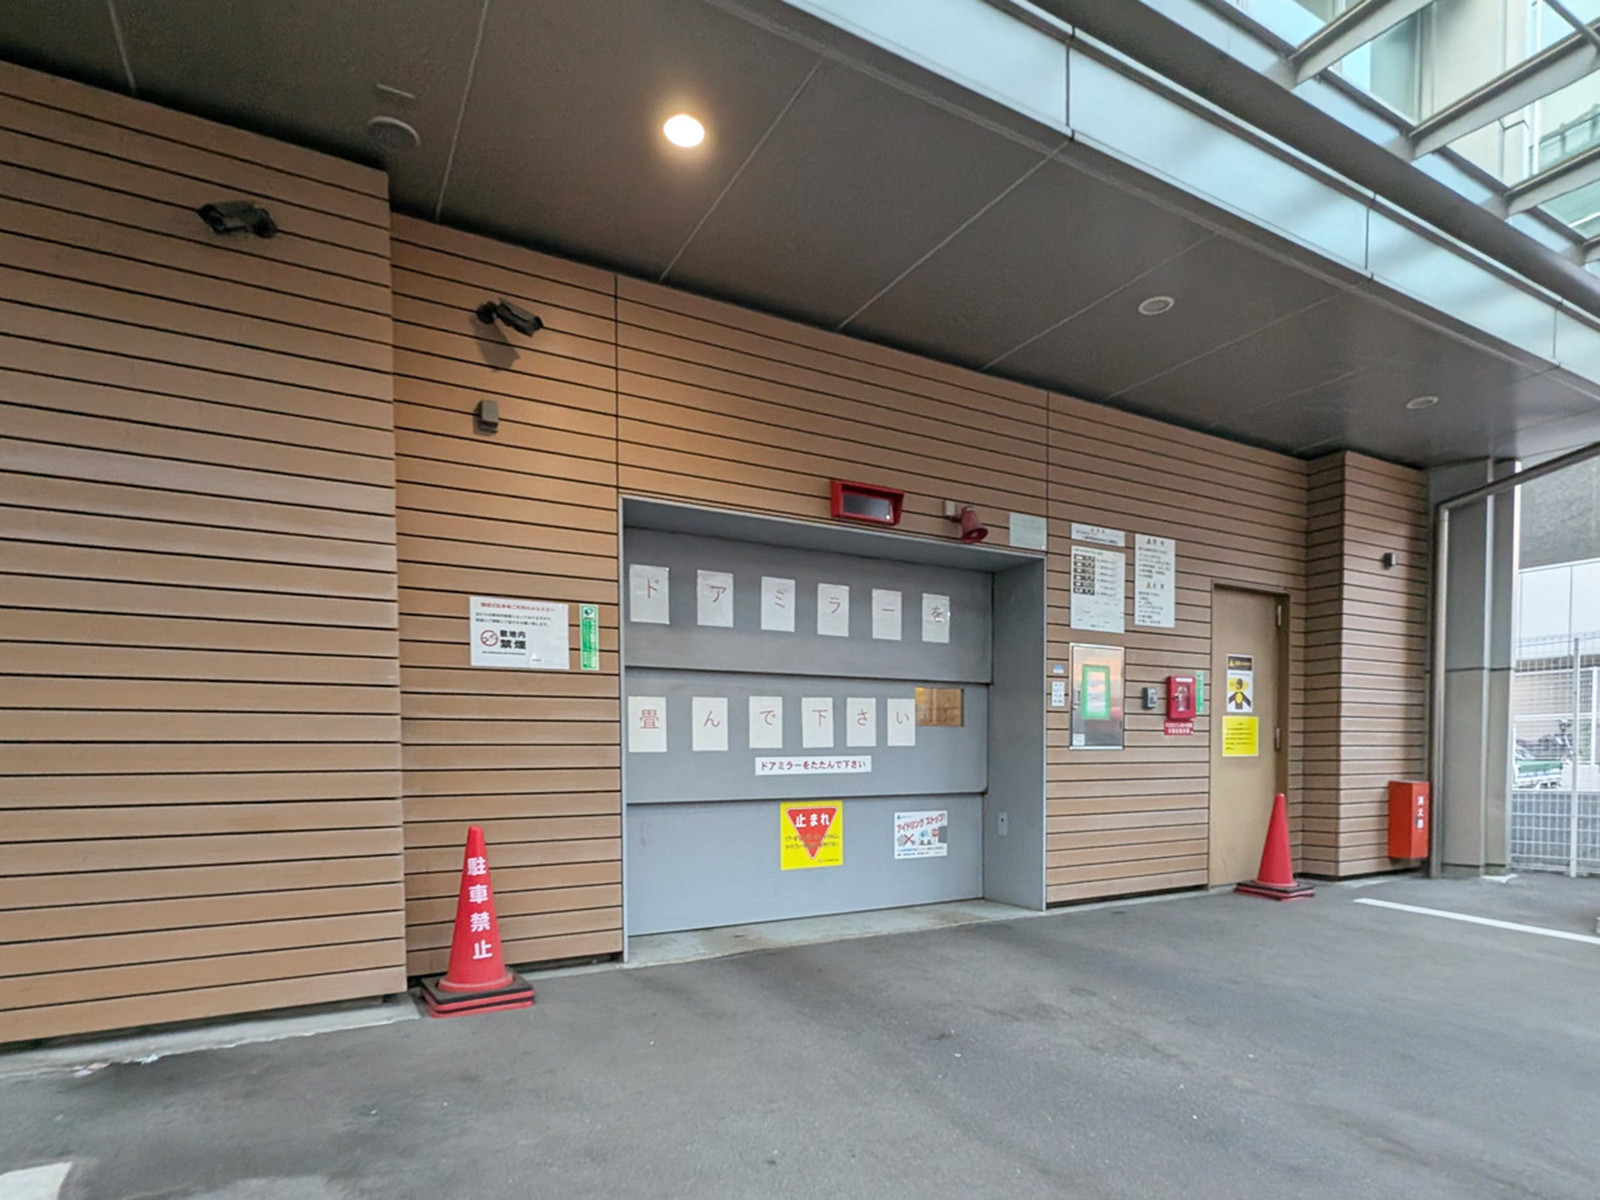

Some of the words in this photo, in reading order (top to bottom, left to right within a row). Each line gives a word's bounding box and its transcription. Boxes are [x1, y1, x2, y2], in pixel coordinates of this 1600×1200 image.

[645, 578, 944, 623] ドアミラーを
[640, 709, 910, 729] 畳んで下さい
[760, 760, 866, 771] ドアミラーをたたんで下さい
[795, 813, 831, 828] 止まれ
[467, 857, 493, 960] 駐車禁止
